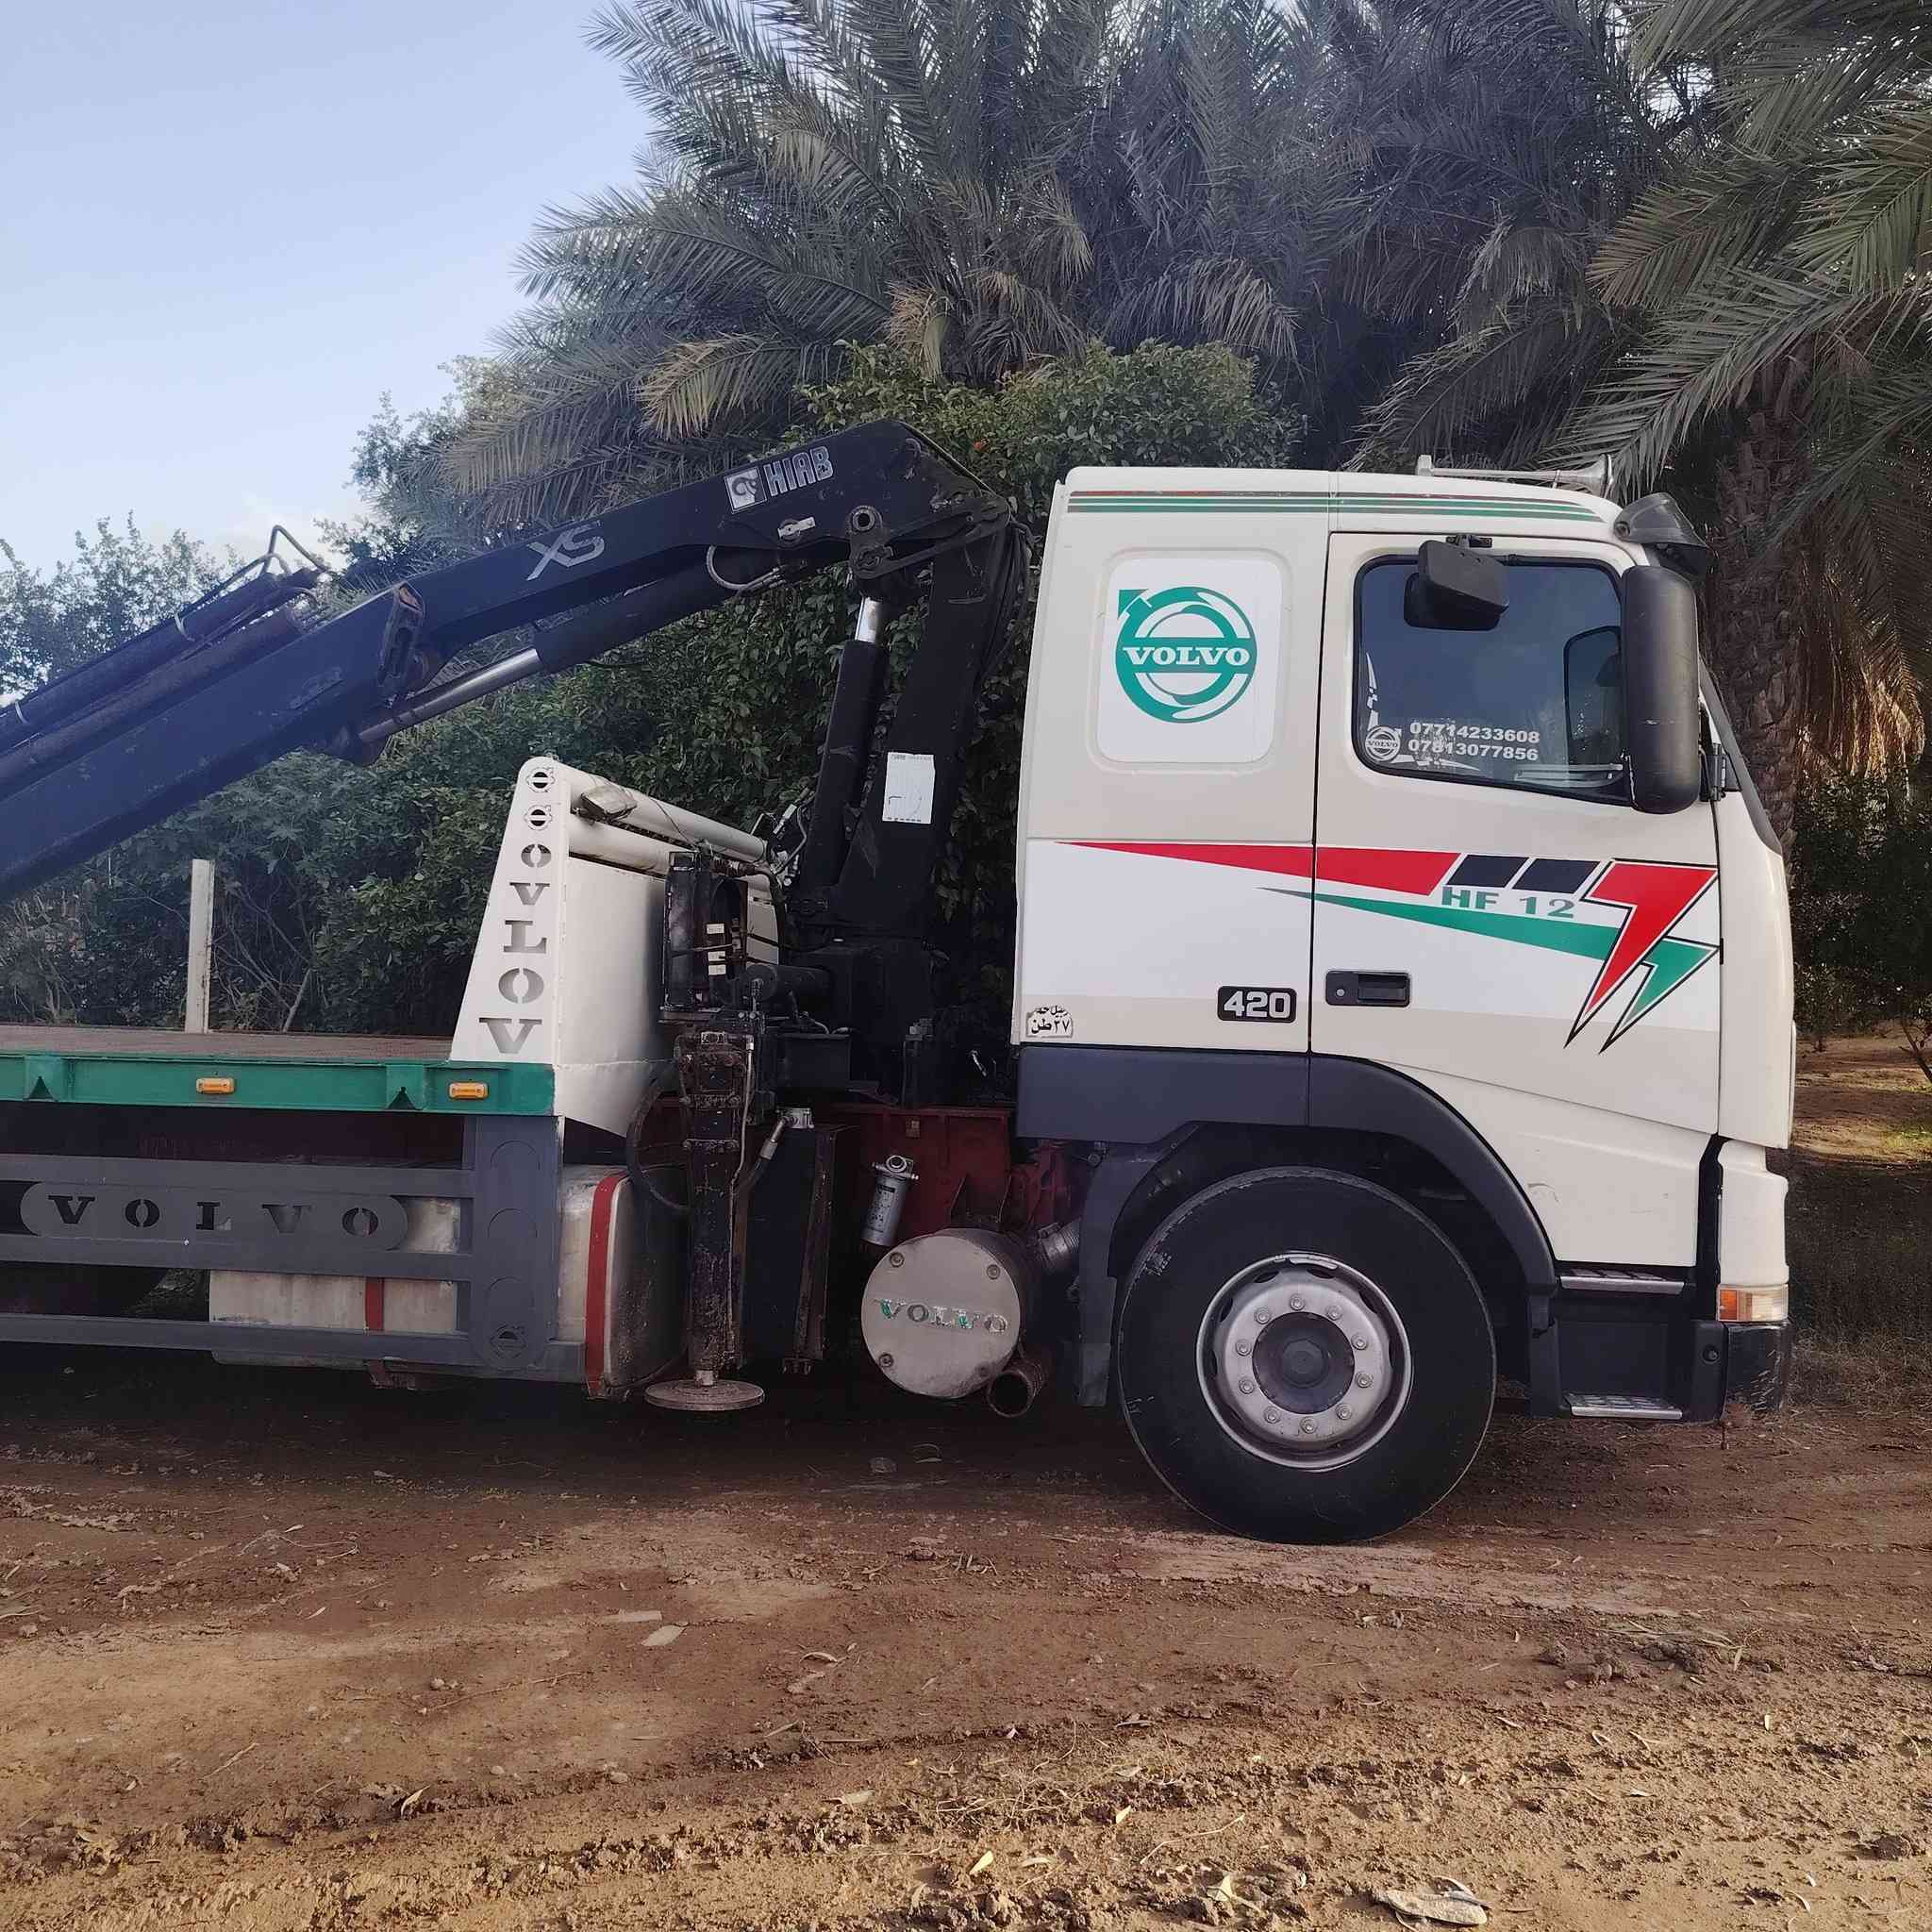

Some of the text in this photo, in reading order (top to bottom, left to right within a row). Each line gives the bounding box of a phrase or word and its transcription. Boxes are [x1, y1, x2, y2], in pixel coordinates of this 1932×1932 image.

[763, 446, 834, 497] HIAB
[525, 523, 605, 581] XS
[1122, 646, 1251, 666] VOLVO
[1368, 740, 1398, 748] VOLVO
[1408, 722, 1541, 744] 07714233608
[1407, 739, 1540, 761] 07813077856
[1441, 886, 1574, 919] HF 12
[1224, 991, 1291, 1019] 420
[47, 1194, 379, 1236] VOLVO
[874, 1298, 1008, 1333] VOLVO
